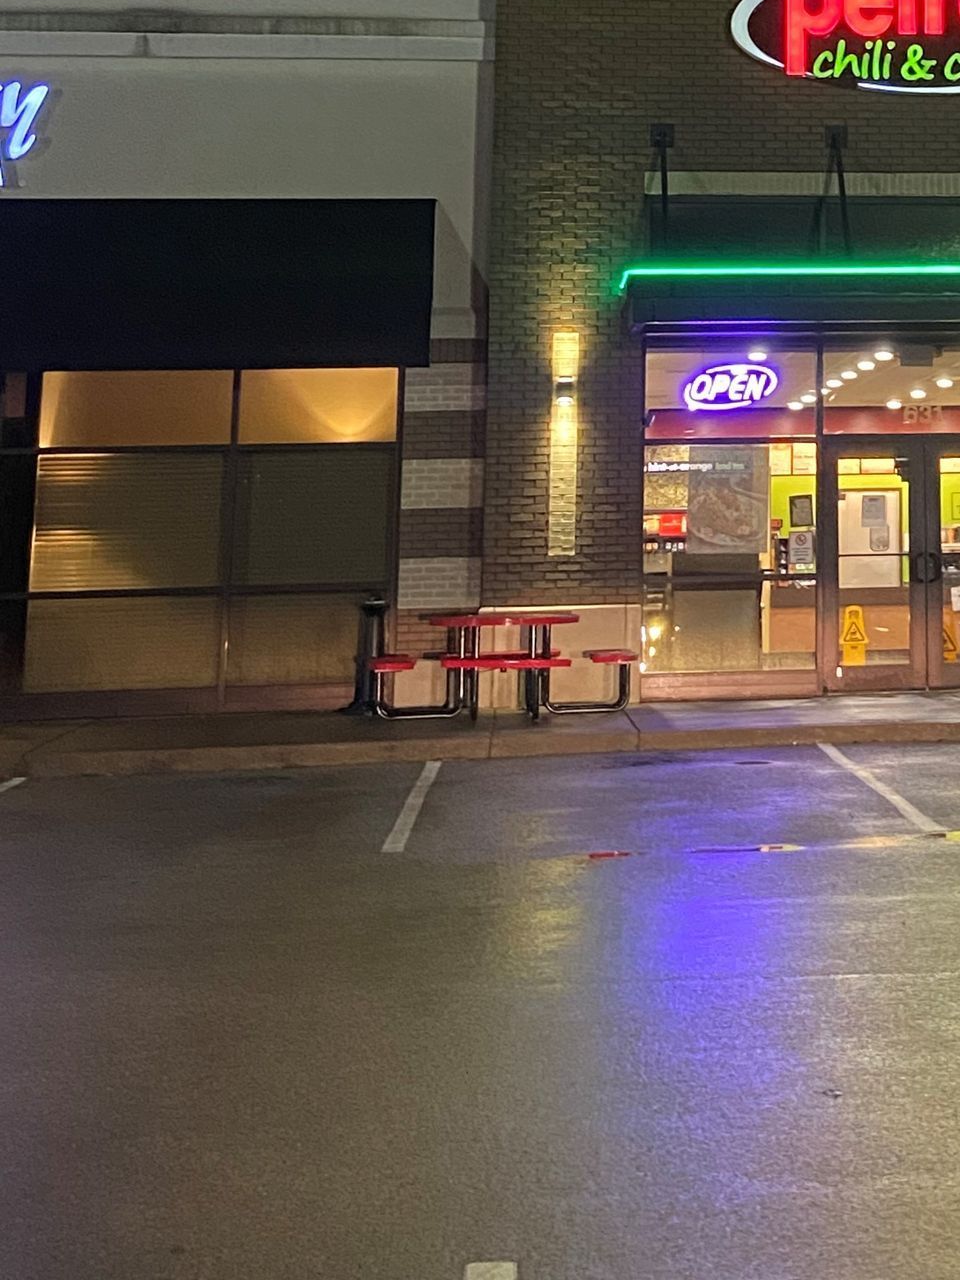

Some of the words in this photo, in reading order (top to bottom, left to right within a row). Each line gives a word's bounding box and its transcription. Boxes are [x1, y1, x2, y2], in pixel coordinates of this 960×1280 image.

[813, 38, 896, 81] chili
[900, 42, 937, 81] &
[0, 81, 49, 160] y
[690, 373, 767, 401] OPEN
[903, 404, 943, 424] 631
